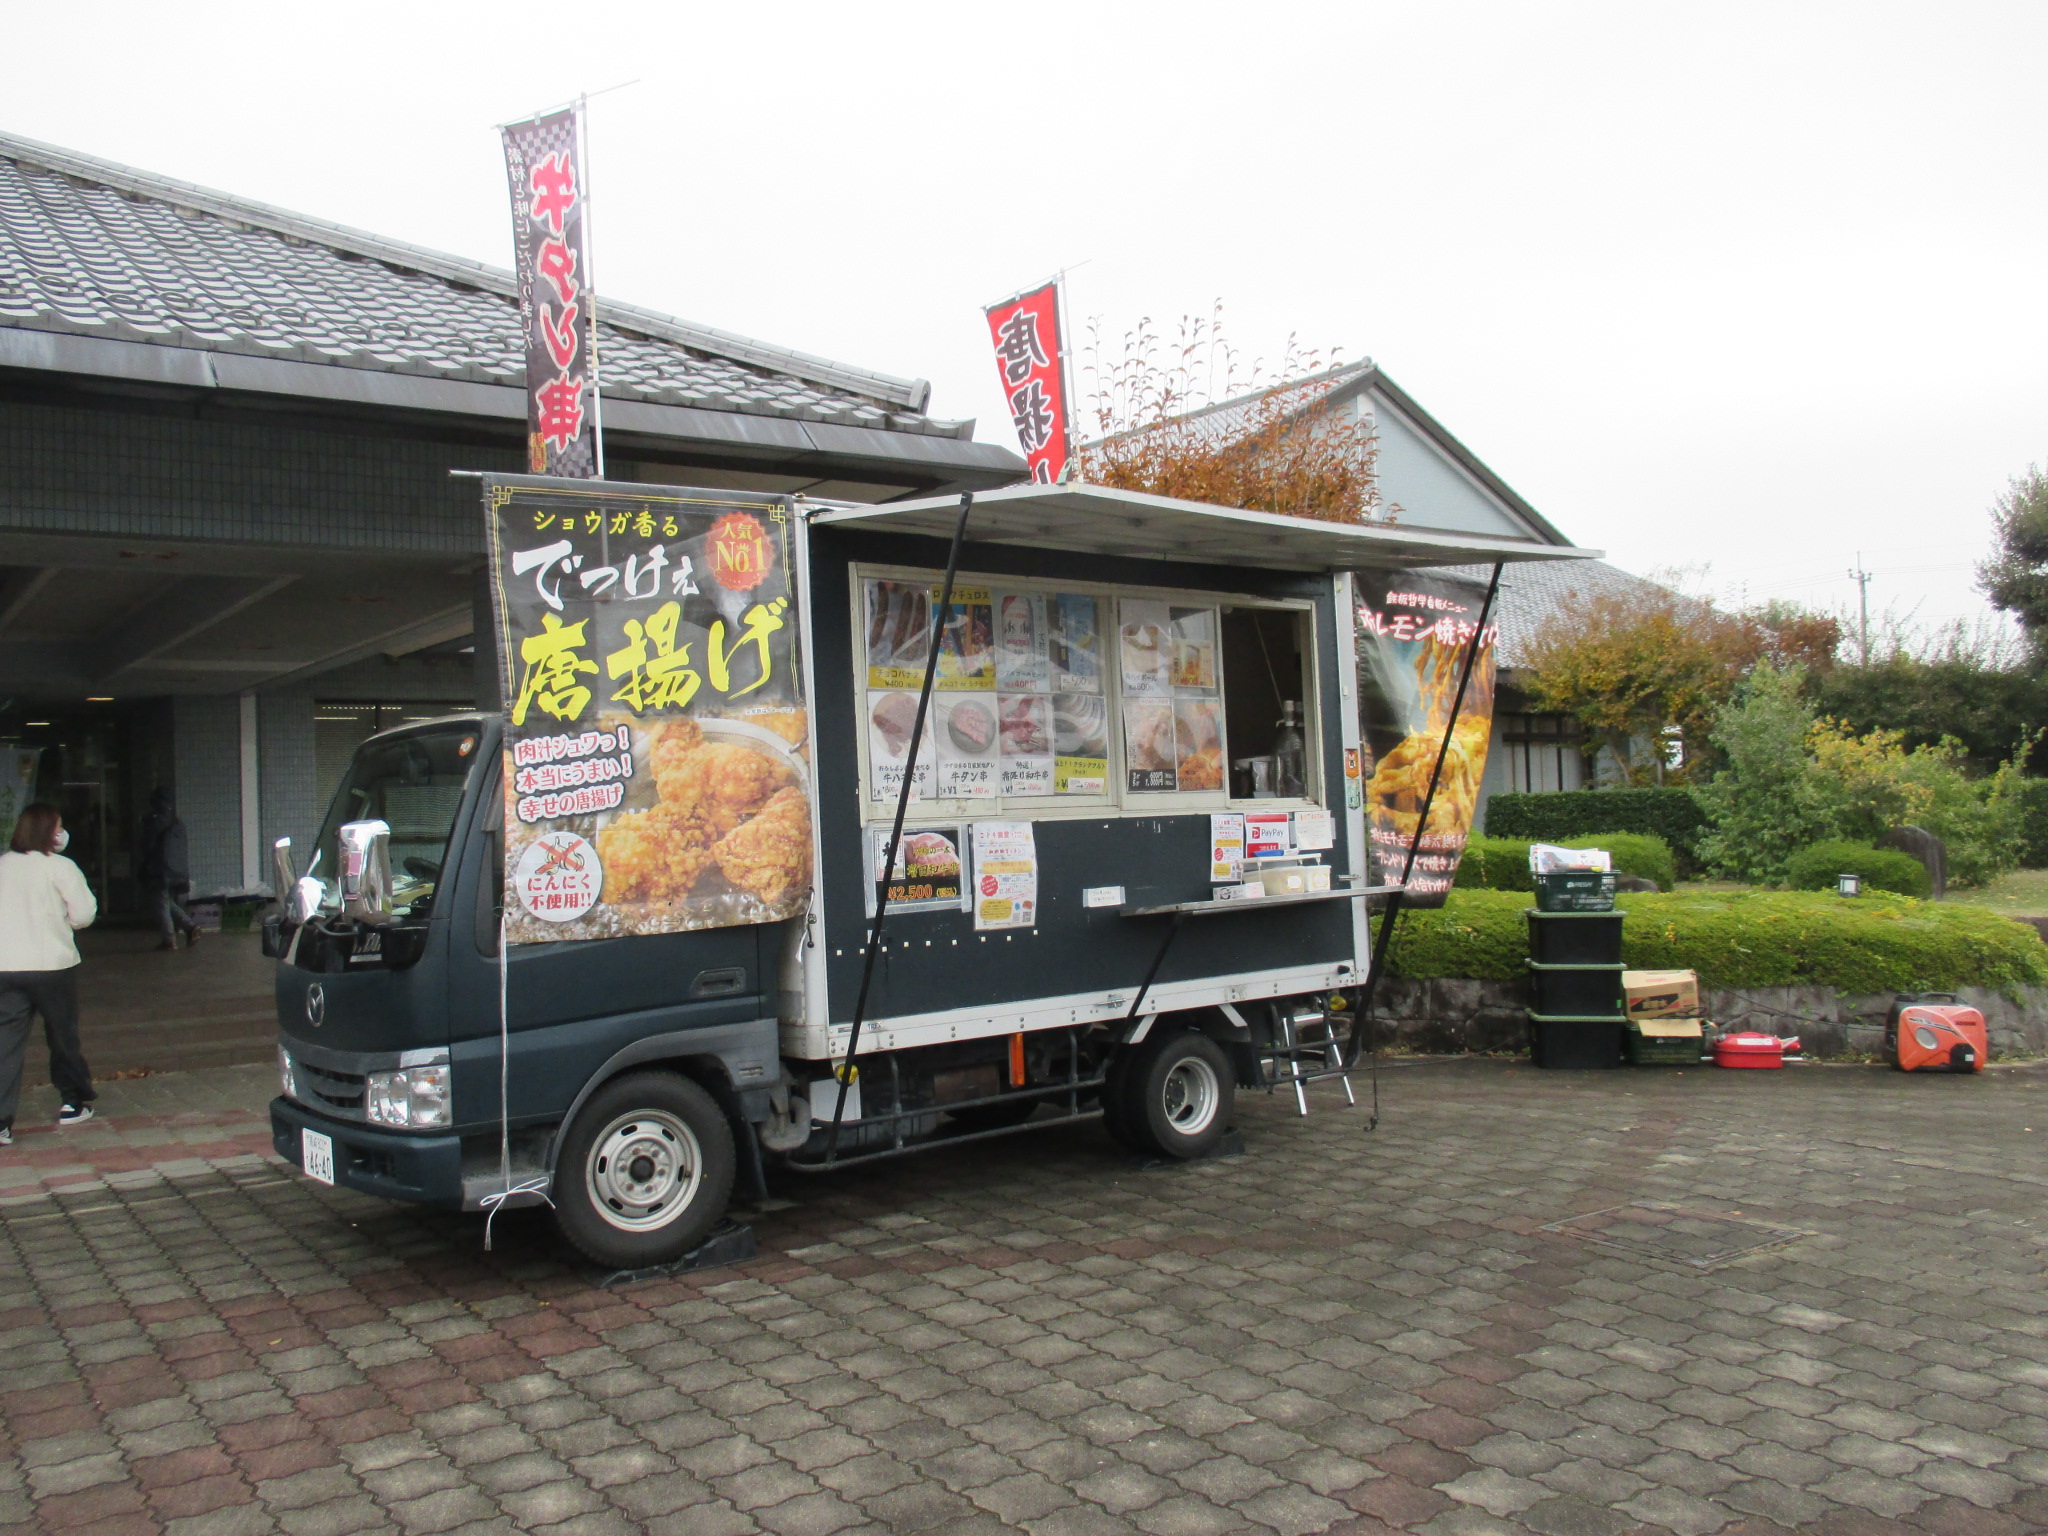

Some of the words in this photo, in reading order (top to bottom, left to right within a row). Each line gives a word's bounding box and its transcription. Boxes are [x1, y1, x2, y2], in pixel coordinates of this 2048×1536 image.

[533, 510, 680, 538] ショウガ香る
[720, 521, 753, 541] 人気
[714, 536, 768, 574] No.1
[511, 596, 788, 727] 唐揚げ
[951, 770, 988, 782] 牛タン串
[519, 783, 624, 820] 幸せの唐揚げ
[1261, 828, 1284, 837] PayPay
[527, 873, 591, 892] にんにく
[888, 884, 932, 902] ¥2,500
